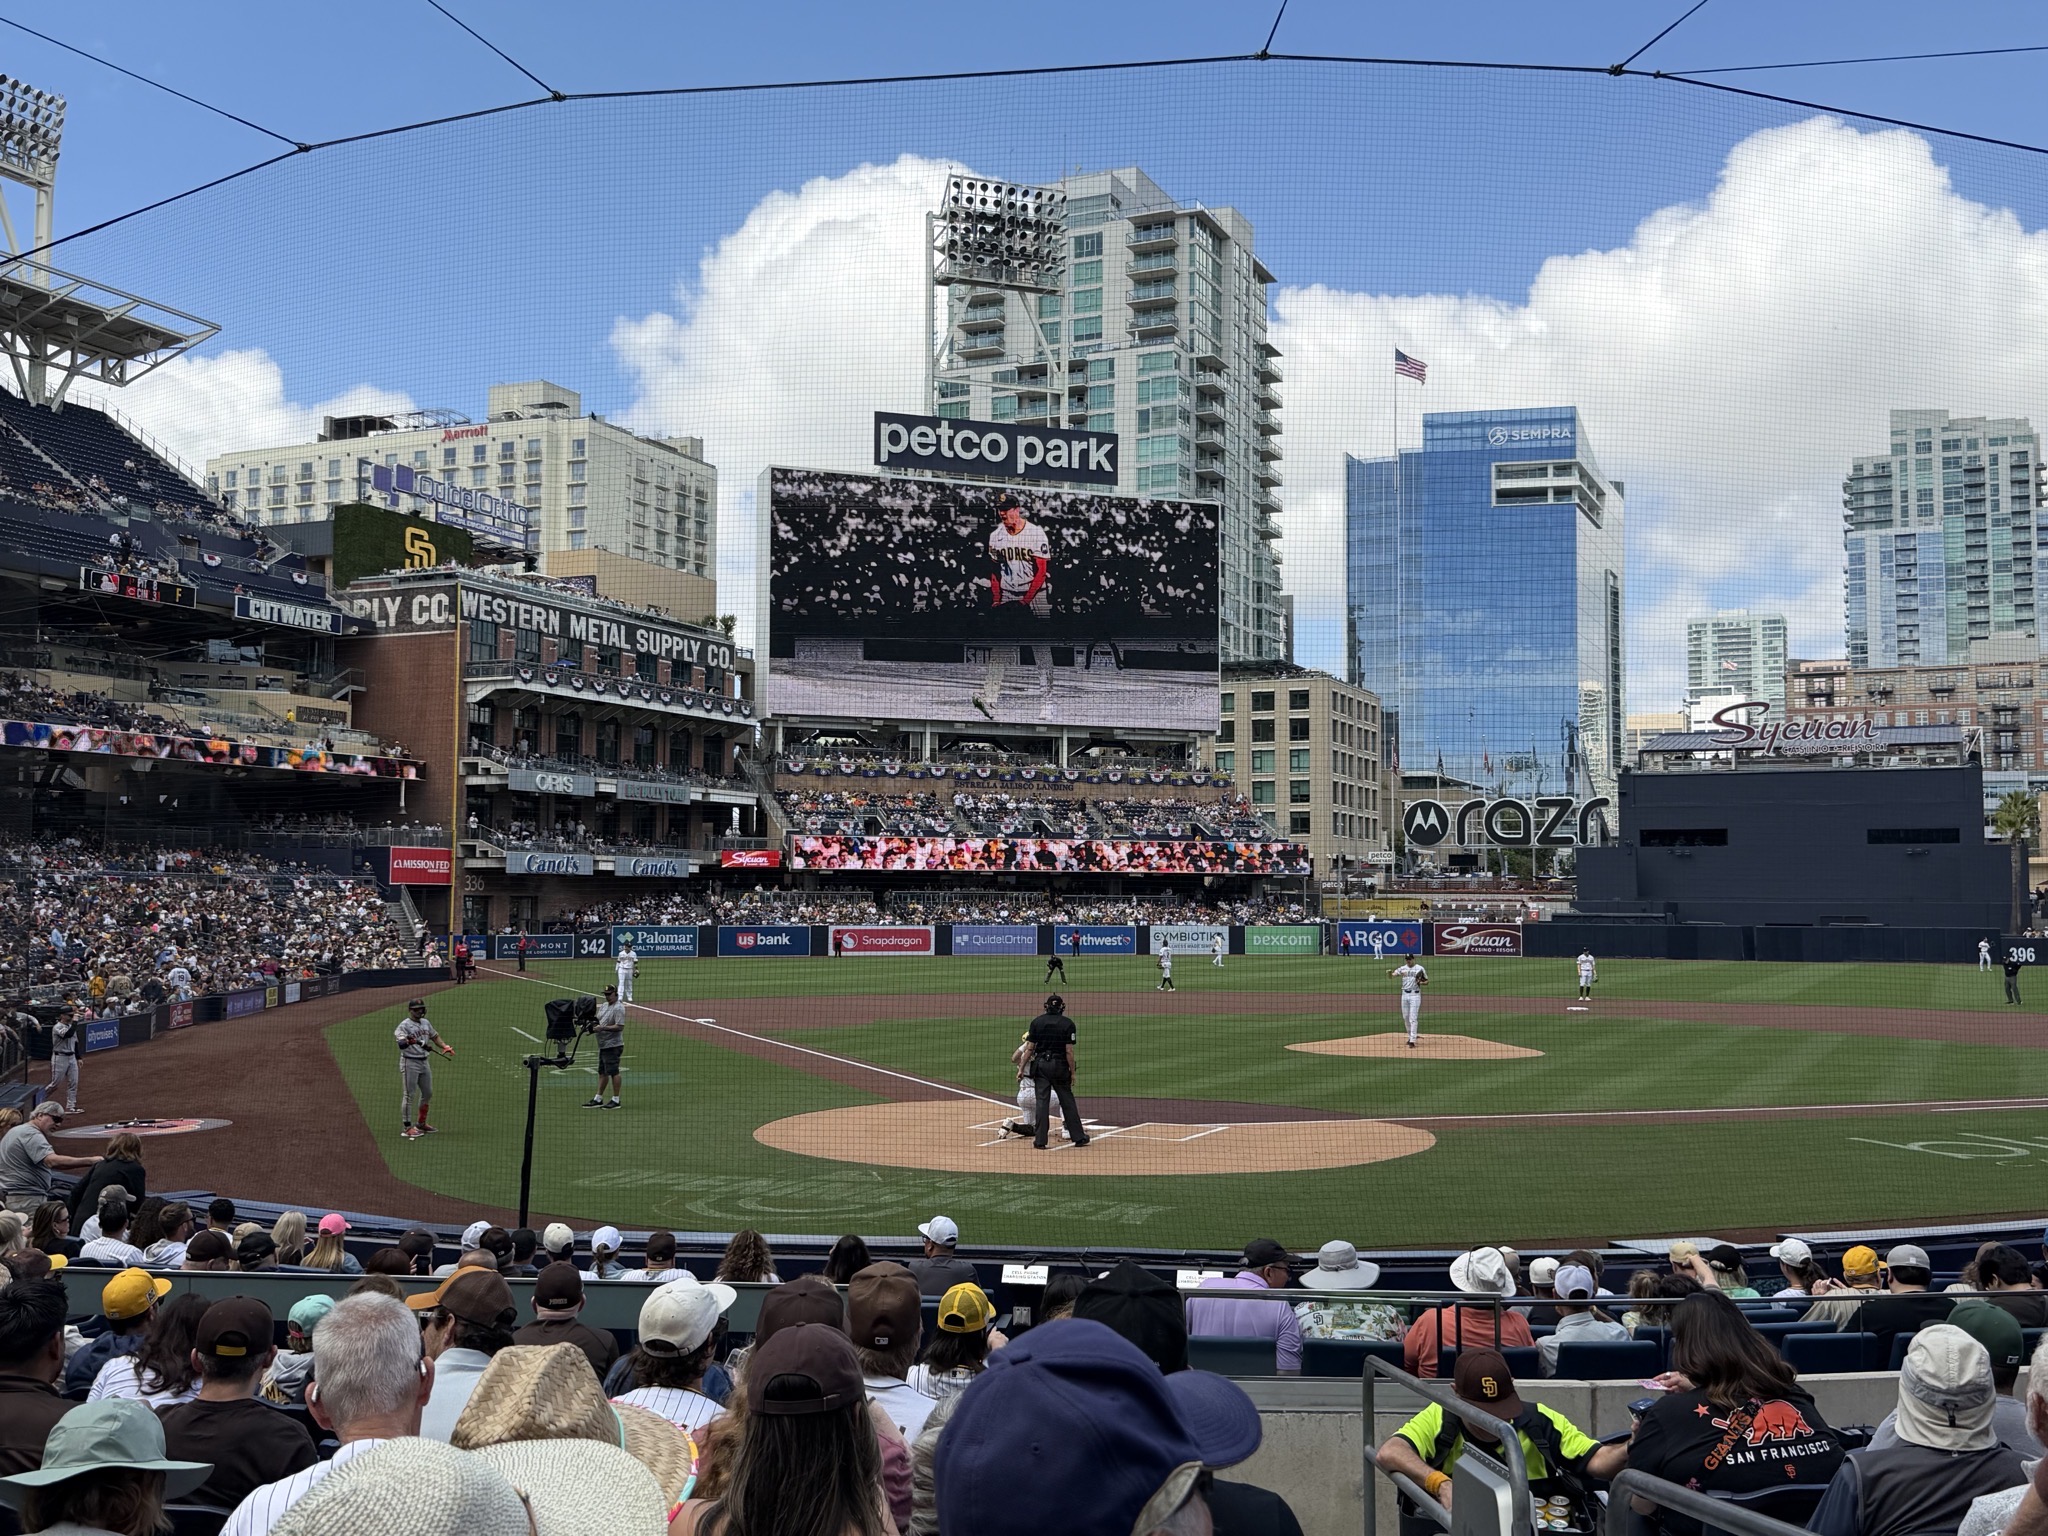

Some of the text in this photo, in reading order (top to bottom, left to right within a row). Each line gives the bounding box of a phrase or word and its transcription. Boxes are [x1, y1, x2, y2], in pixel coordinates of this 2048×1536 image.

[441, 425, 488, 443] Marriott
[1511, 428, 1571, 440] SEMPRA
[880, 420, 1114, 474] petco park
[418, 475, 528, 526] QuidelOrtho
[175, 587, 182, 603] F
[249, 600, 332, 631] CUTWATER
[412, 593, 455, 625] CO.
[461, 588, 734, 671] WESTERN METAL SUPPLY CO.
[1709, 701, 1880, 756] Sycuan
[1782, 743, 1888, 755] CASINO RESORT
[536, 774, 573, 793] ORIS
[955, 781, 1074, 791] ESTRELLA JALISCO LANDING
[1455, 796, 1610, 848] razr
[403, 860, 450, 869] MISSION FED
[525, 854, 580, 874] Canel's
[631, 858, 678, 877] Canel's
[731, 851, 769, 867] Sycuan
[464, 875, 485, 891] 336
[580, 938, 605, 954] 342
[637, 931, 693, 944] Palomar
[862, 935, 922, 947] Snapdragon
[972, 934, 1033, 945] QuidelOrtho
[1060, 933, 1122, 946] Sothwest
[1440, 926, 1513, 953] Sycuan
[2009, 946, 2036, 963] 396
[119, 982, 128, 990] 23
[1704, 1411, 1753, 1471] GIANTS
[1726, 1440, 1830, 1466] SAN FRANCISCO
